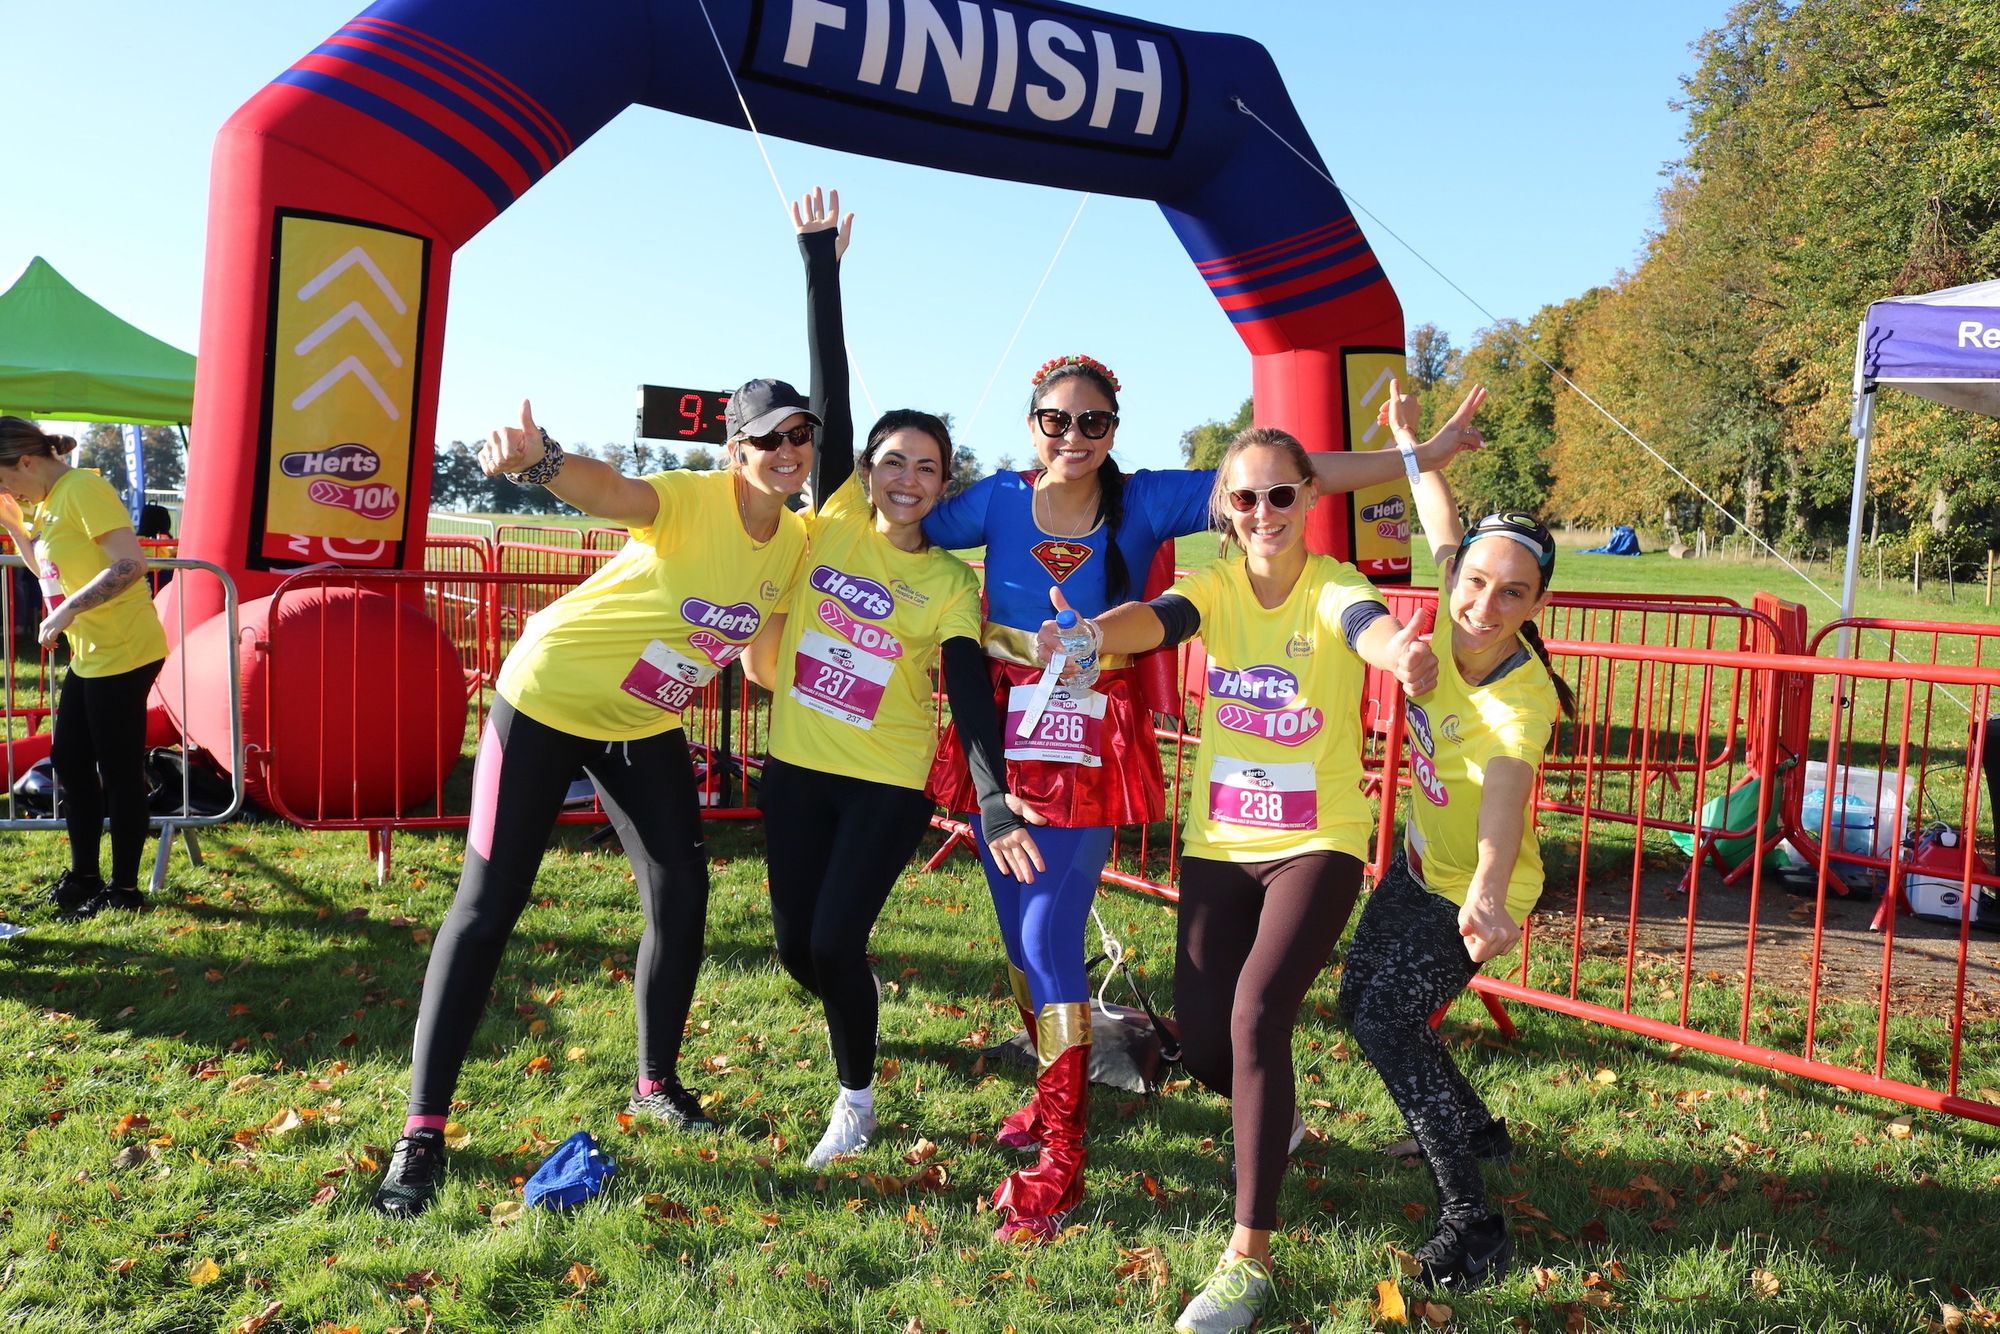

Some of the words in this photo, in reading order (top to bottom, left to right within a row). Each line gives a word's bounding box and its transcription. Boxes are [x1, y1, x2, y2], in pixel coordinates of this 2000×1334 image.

[783, 0, 1162, 135] FINISH
[303, 453, 377, 473] Herts
[353, 487, 396, 510] 10K
[1373, 501, 1404, 519] Herts
[822, 571, 891, 616] Herts
[700, 605, 759, 633] Herts
[852, 623, 900, 652] 10K
[833, 648, 851, 657] Herts
[841, 660, 854, 669] 10K
[655, 679, 694, 707] 436
[813, 665, 857, 700] 237
[1218, 672, 1295, 699] Herts
[846, 713, 862, 724] 237
[1040, 713, 1084, 742] 236
[1263, 707, 1319, 737] 10K
[1406, 702, 1433, 754] erts
[1246, 769, 1265, 777] Herts
[1258, 779, 1273, 787] 10K
[1416, 755, 1445, 801] 10K
[1240, 790, 1283, 821] 238
